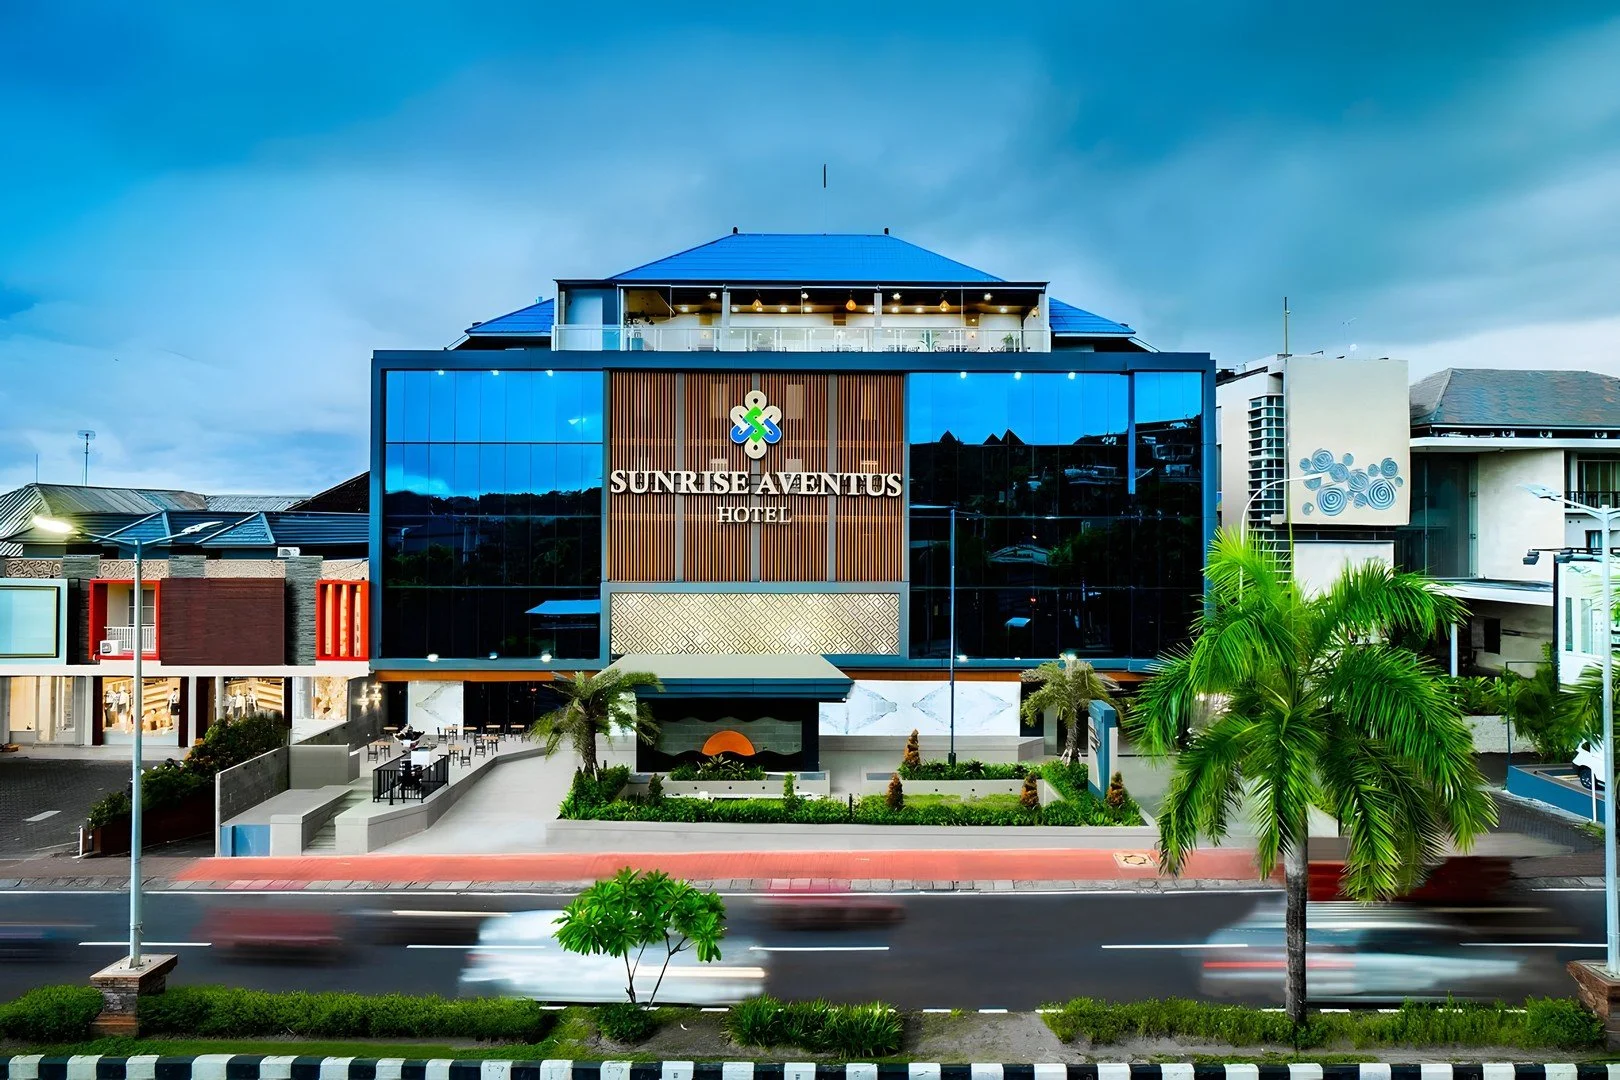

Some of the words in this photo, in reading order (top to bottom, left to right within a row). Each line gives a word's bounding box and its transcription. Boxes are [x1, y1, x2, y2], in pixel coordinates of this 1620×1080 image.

[610, 469, 750, 494] SUNRISE
[755, 471, 902, 497] AVENTUS
[717, 506, 792, 523] HOTEL
